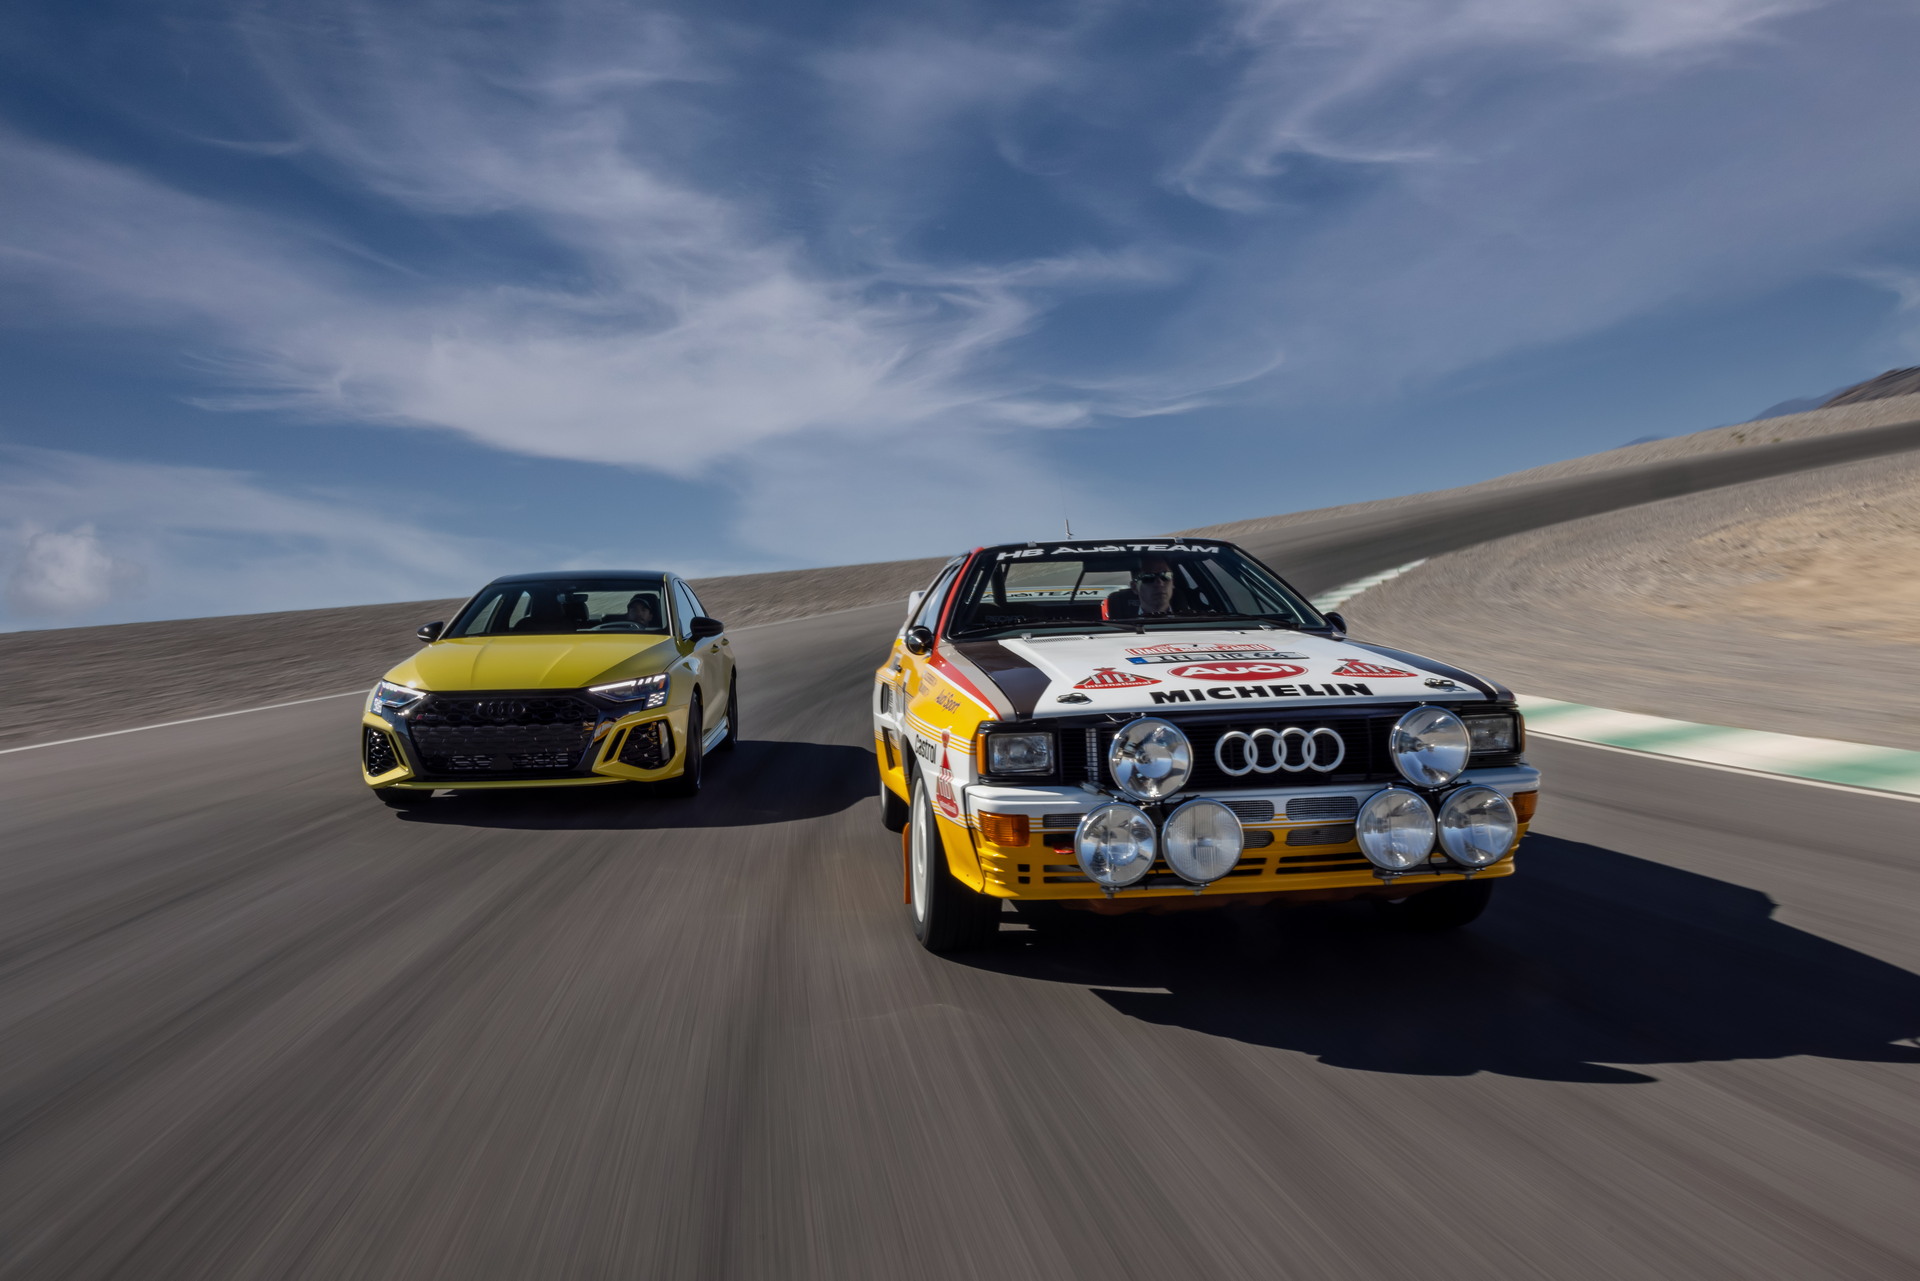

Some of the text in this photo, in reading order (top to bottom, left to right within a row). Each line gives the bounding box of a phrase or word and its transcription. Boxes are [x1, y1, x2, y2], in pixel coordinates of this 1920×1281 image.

[996, 549, 1046, 560] HB
[1090, 673, 1138, 684] HB
[1084, 680, 1153, 689] international
[1148, 683, 1374, 704] MICHELIN
[915, 733, 937, 764] Castrol
